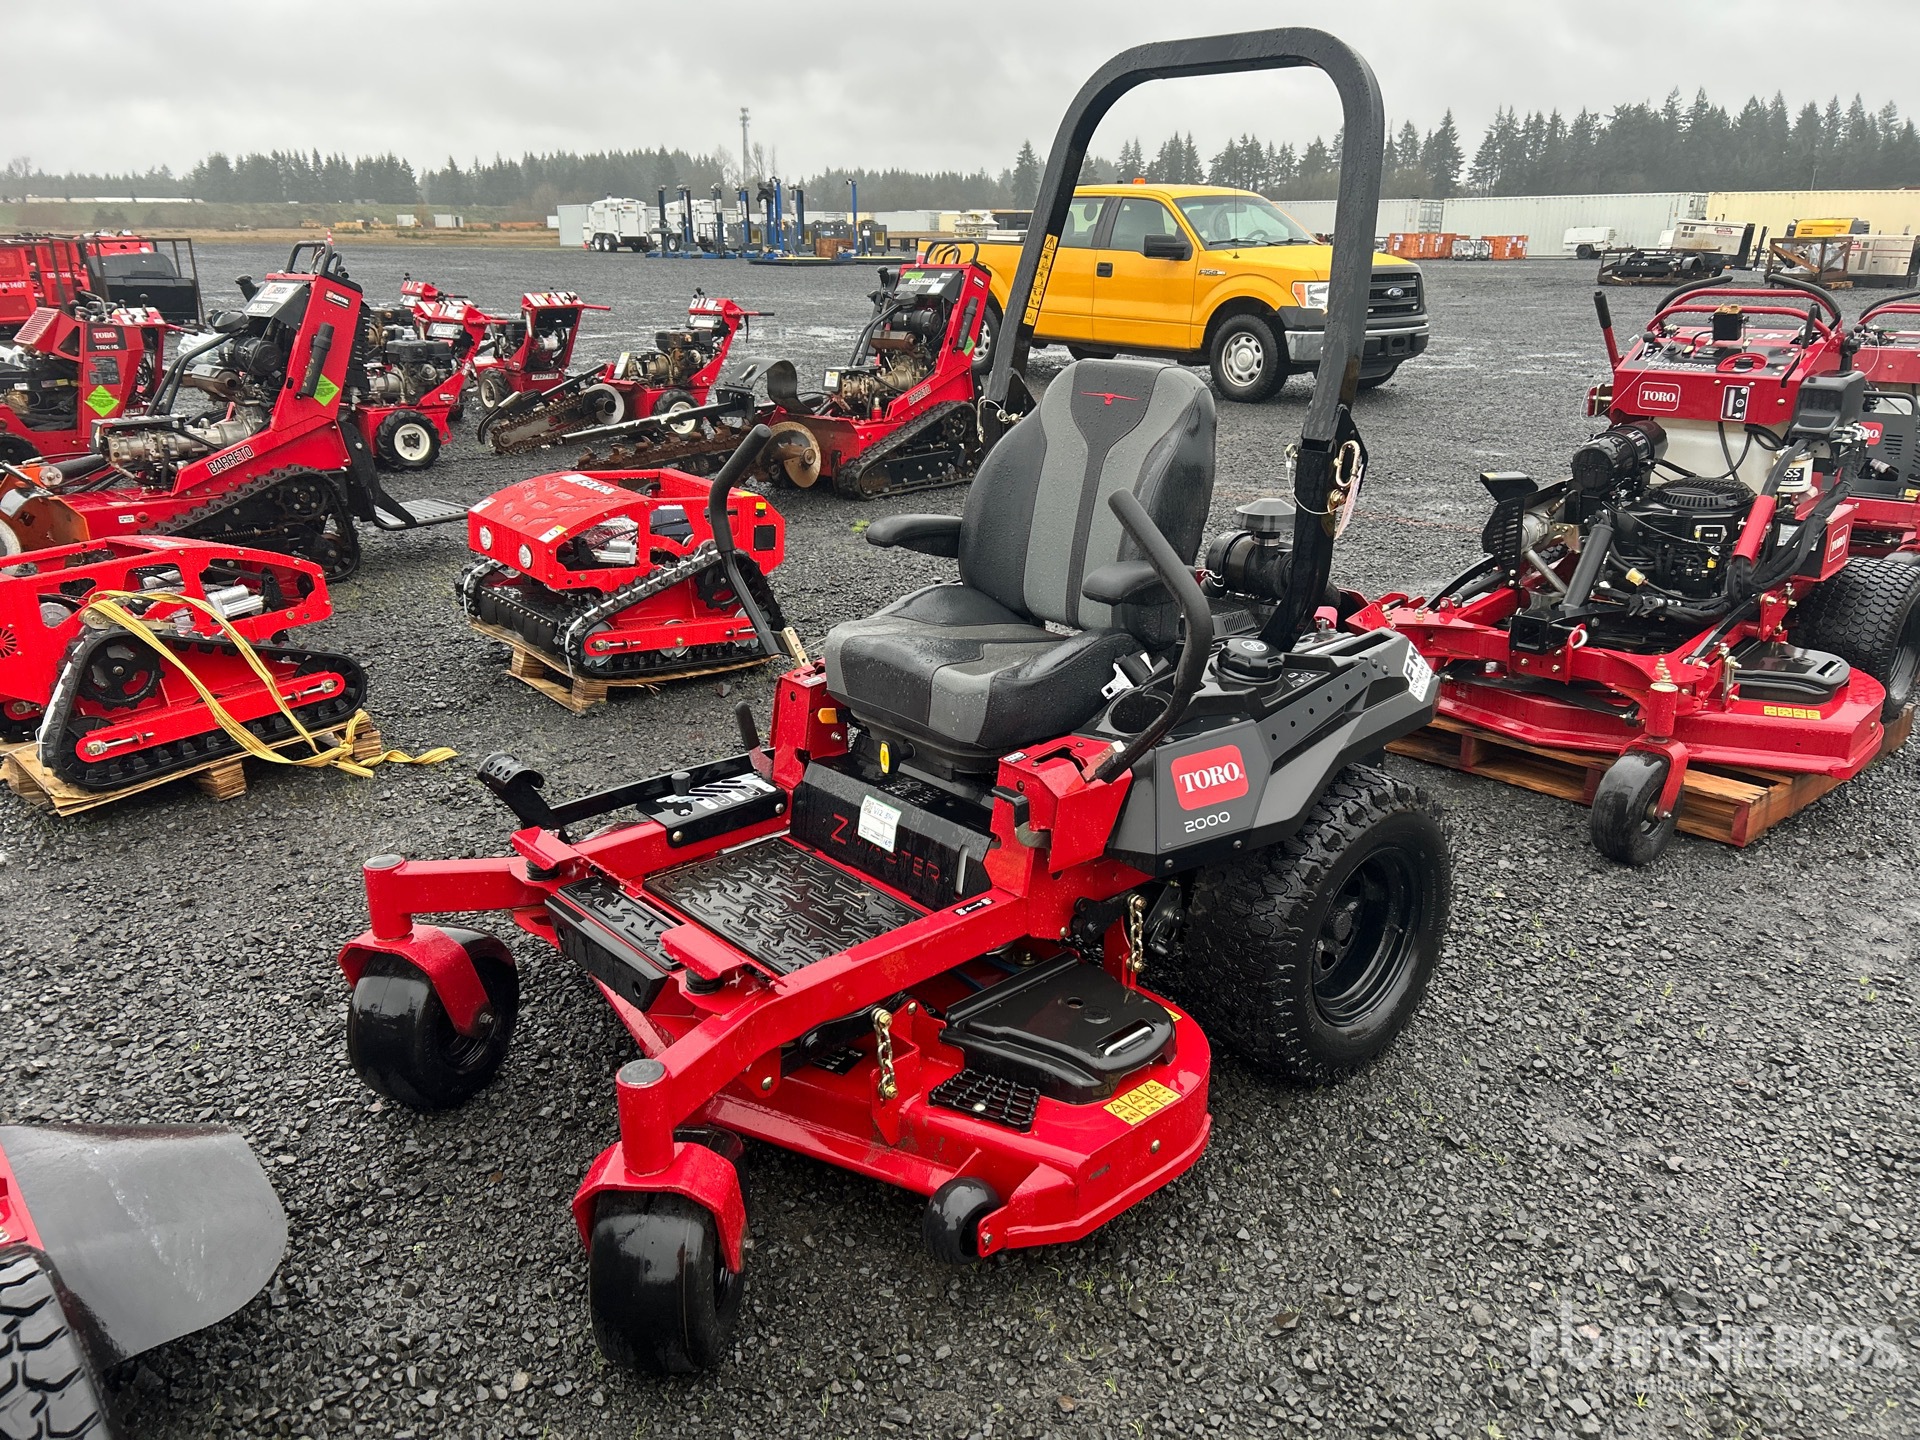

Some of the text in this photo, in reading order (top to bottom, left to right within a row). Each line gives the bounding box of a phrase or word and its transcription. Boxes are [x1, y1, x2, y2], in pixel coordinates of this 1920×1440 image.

[93, 331, 117, 339] TORO
[1642, 391, 1676, 403] TORO
[206, 445, 255, 476] BARRETO
[1831, 534, 1846, 552] TORO
[1179, 762, 1240, 793] TORO
[831, 812, 849, 845] Z
[1184, 811, 1230, 833] 2000
